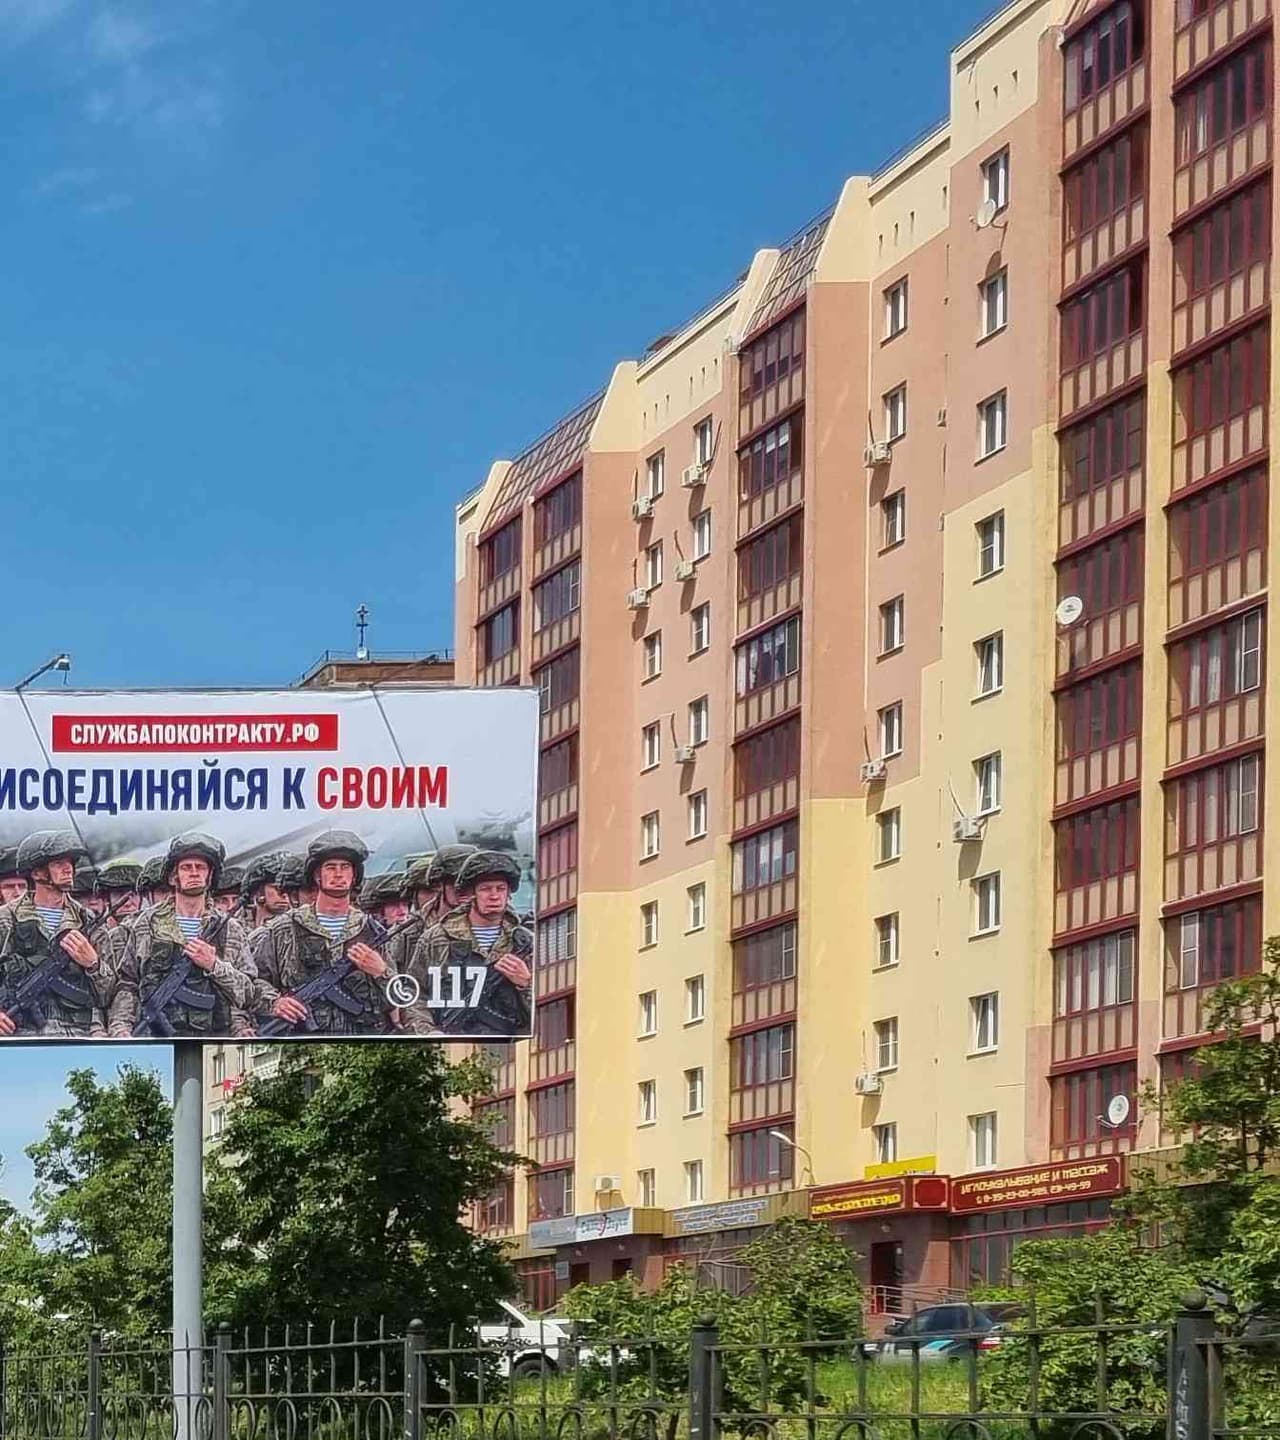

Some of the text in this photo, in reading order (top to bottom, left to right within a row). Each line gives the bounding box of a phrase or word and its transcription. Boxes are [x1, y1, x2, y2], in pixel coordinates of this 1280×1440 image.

[70, 723, 320, 745] СЛУЖБАПОКОНТРАКТУ.РФ
[282, 767, 306, 811] К
[316, 766, 449, 810] СВОИМ
[427, 966, 487, 1008] 117
